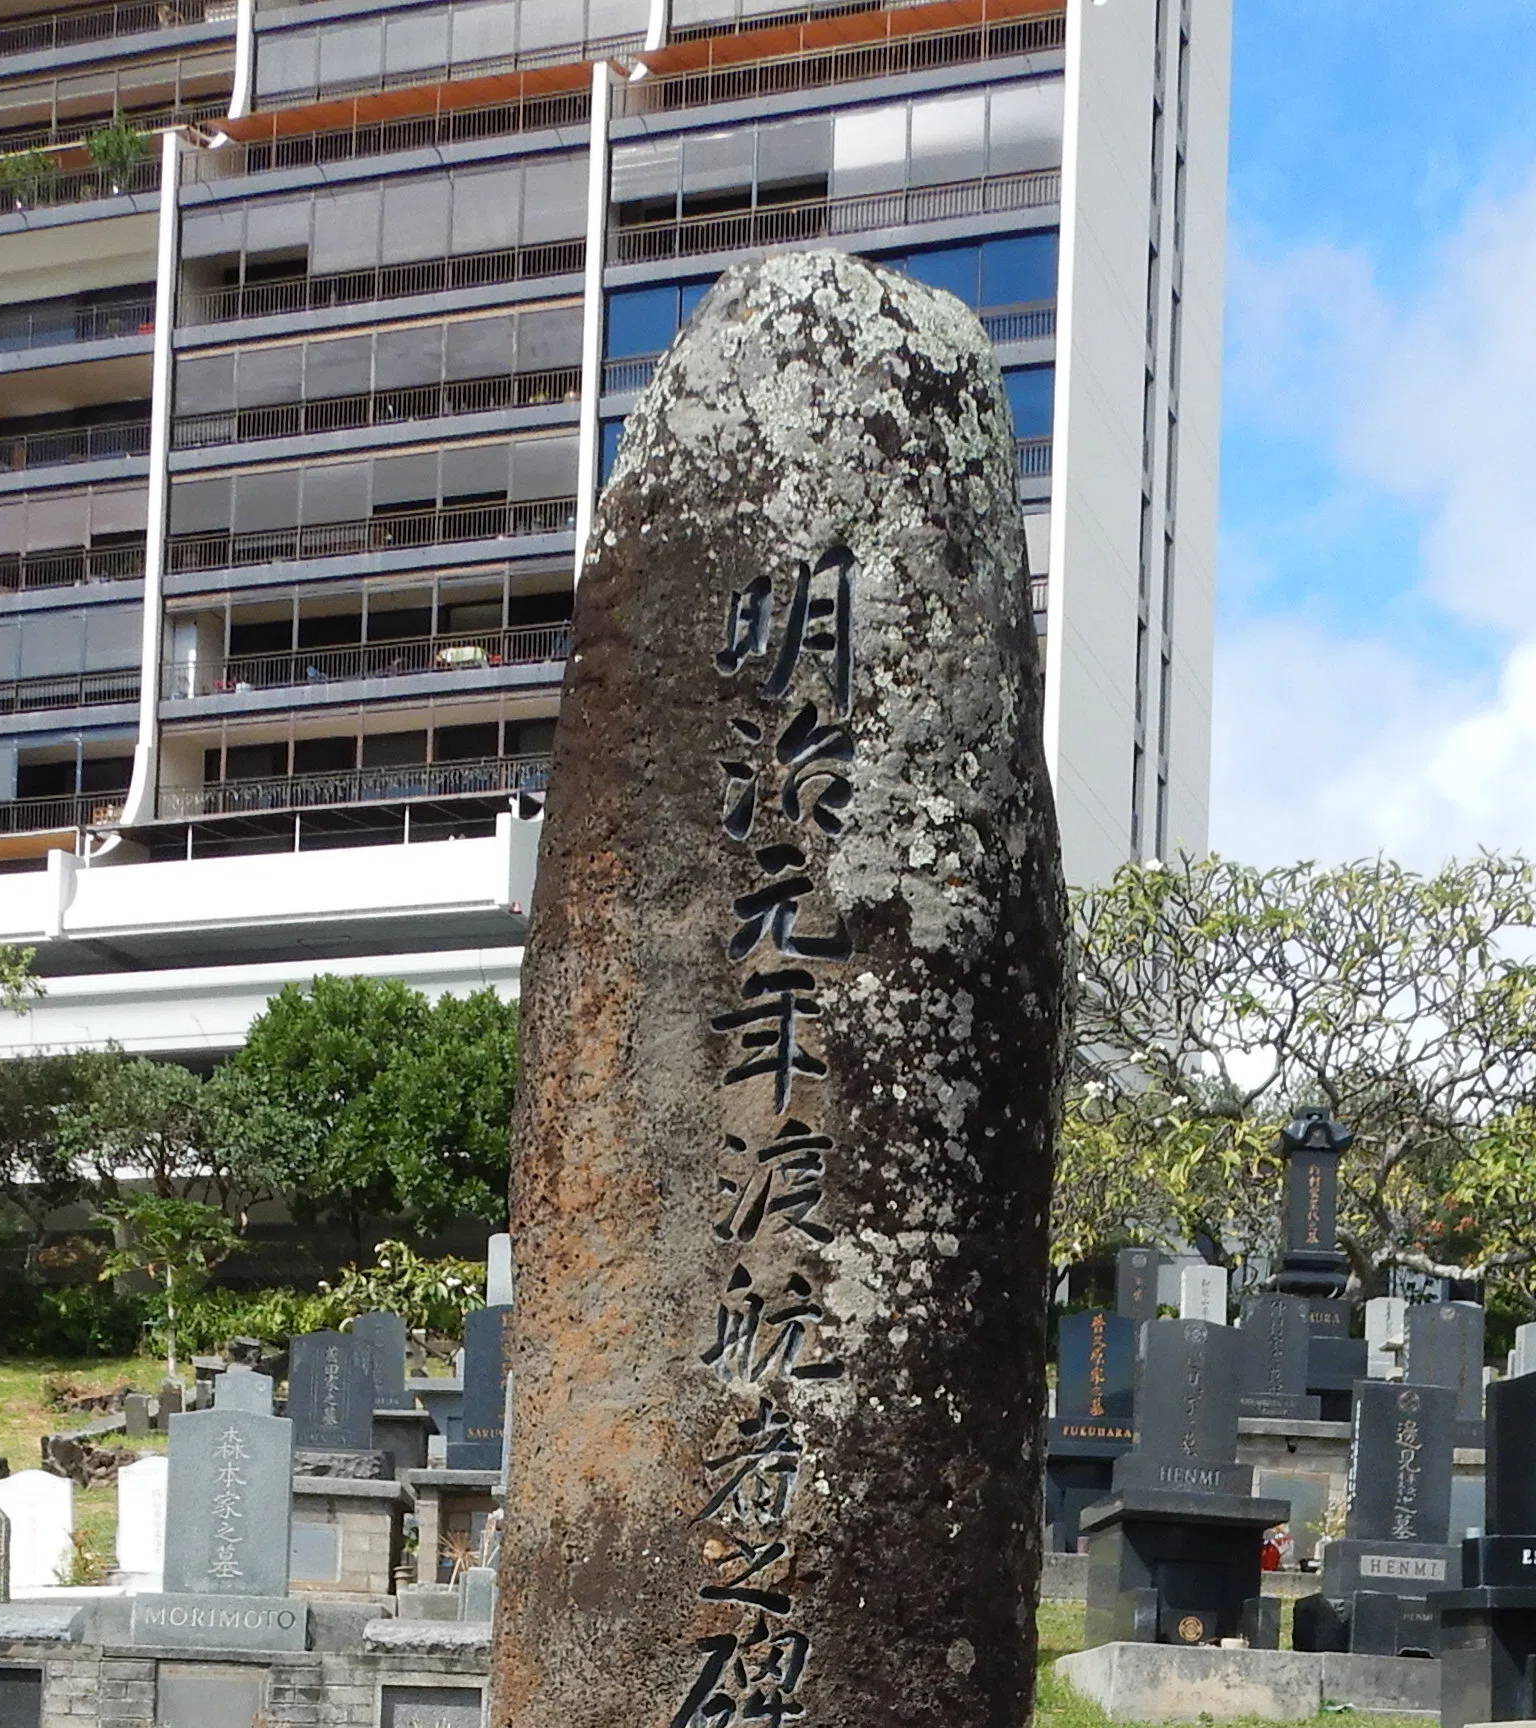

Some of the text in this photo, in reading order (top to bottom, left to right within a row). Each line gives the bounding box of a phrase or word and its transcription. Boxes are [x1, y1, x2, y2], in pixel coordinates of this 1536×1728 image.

[1159, 1465, 1221, 1486] HENMI
[208, 1425, 252, 1578] 森本家之墓
[1370, 1559, 1437, 1577] HENMI
[145, 1606, 297, 1630] MORIMOTO
